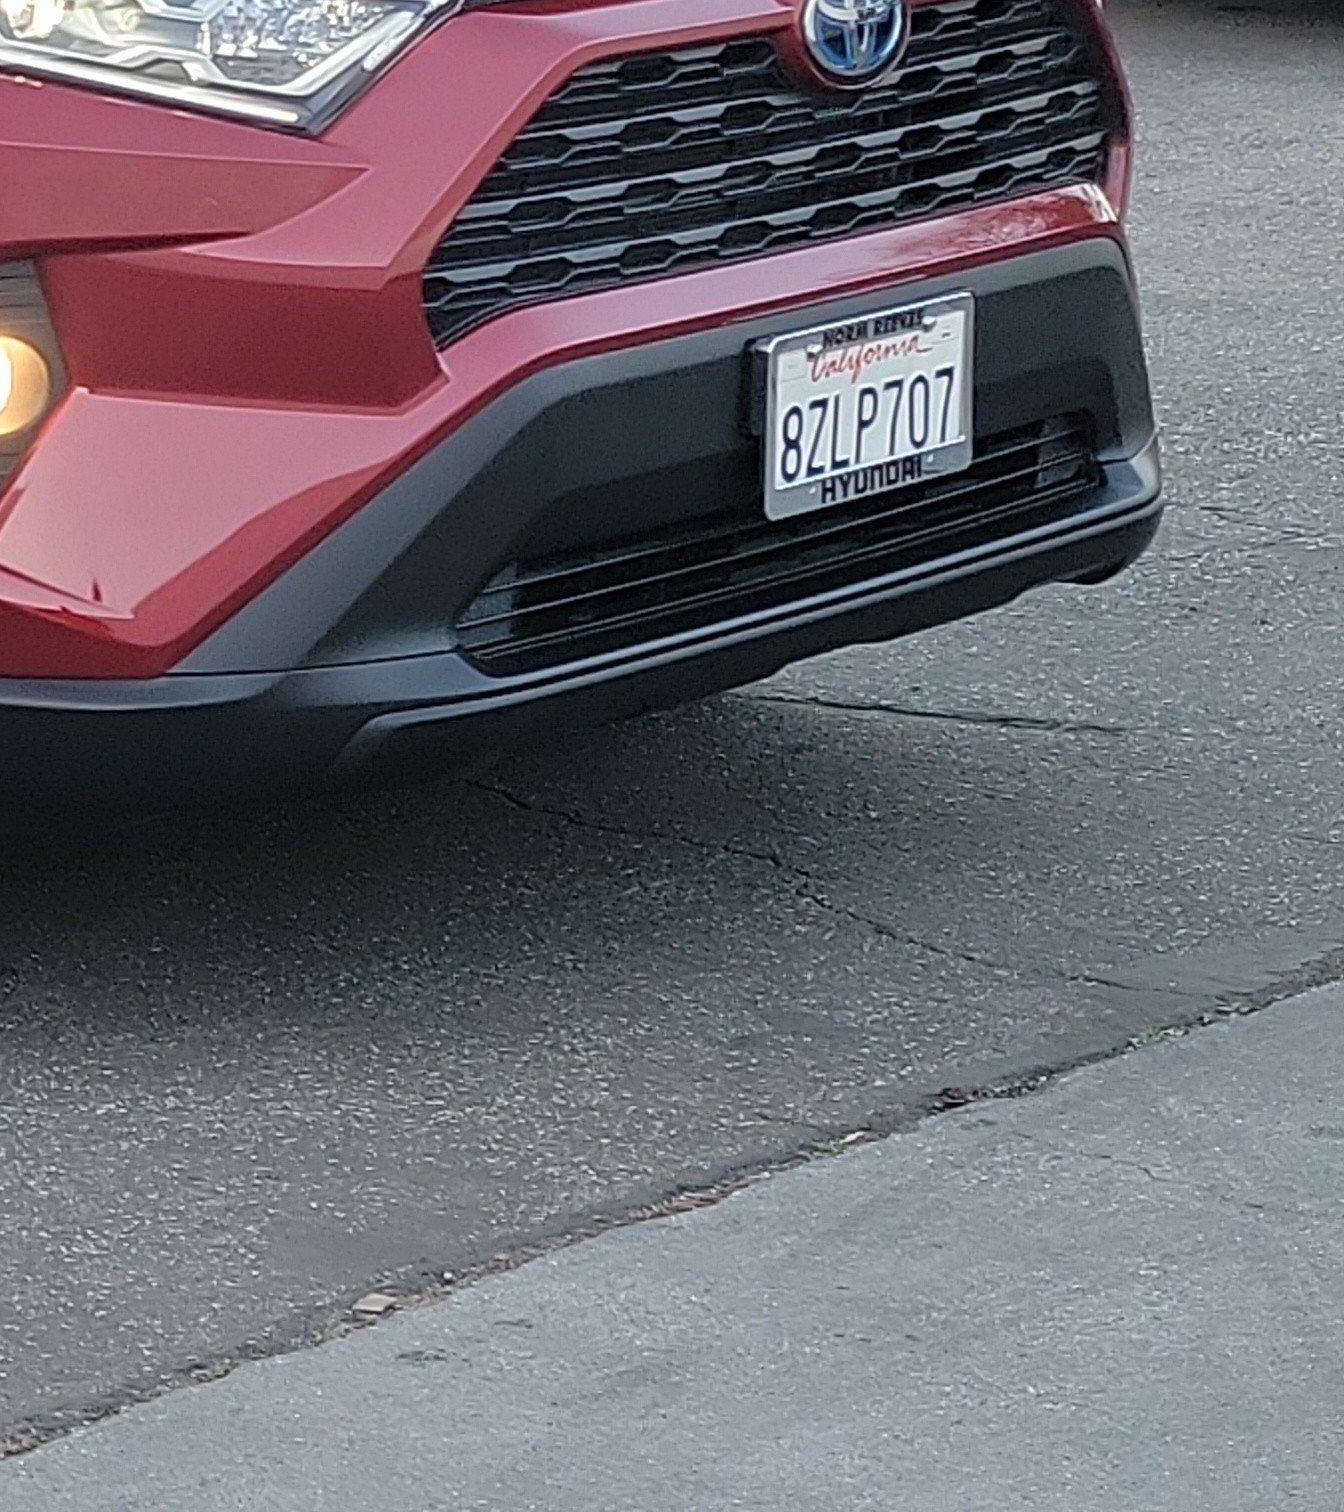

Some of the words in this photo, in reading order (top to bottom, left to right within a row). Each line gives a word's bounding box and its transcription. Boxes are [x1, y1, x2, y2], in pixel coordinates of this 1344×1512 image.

[811, 334, 932, 383] California
[780, 365, 956, 484] 8ZLP707
[821, 456, 923, 504] HYUNDAI
